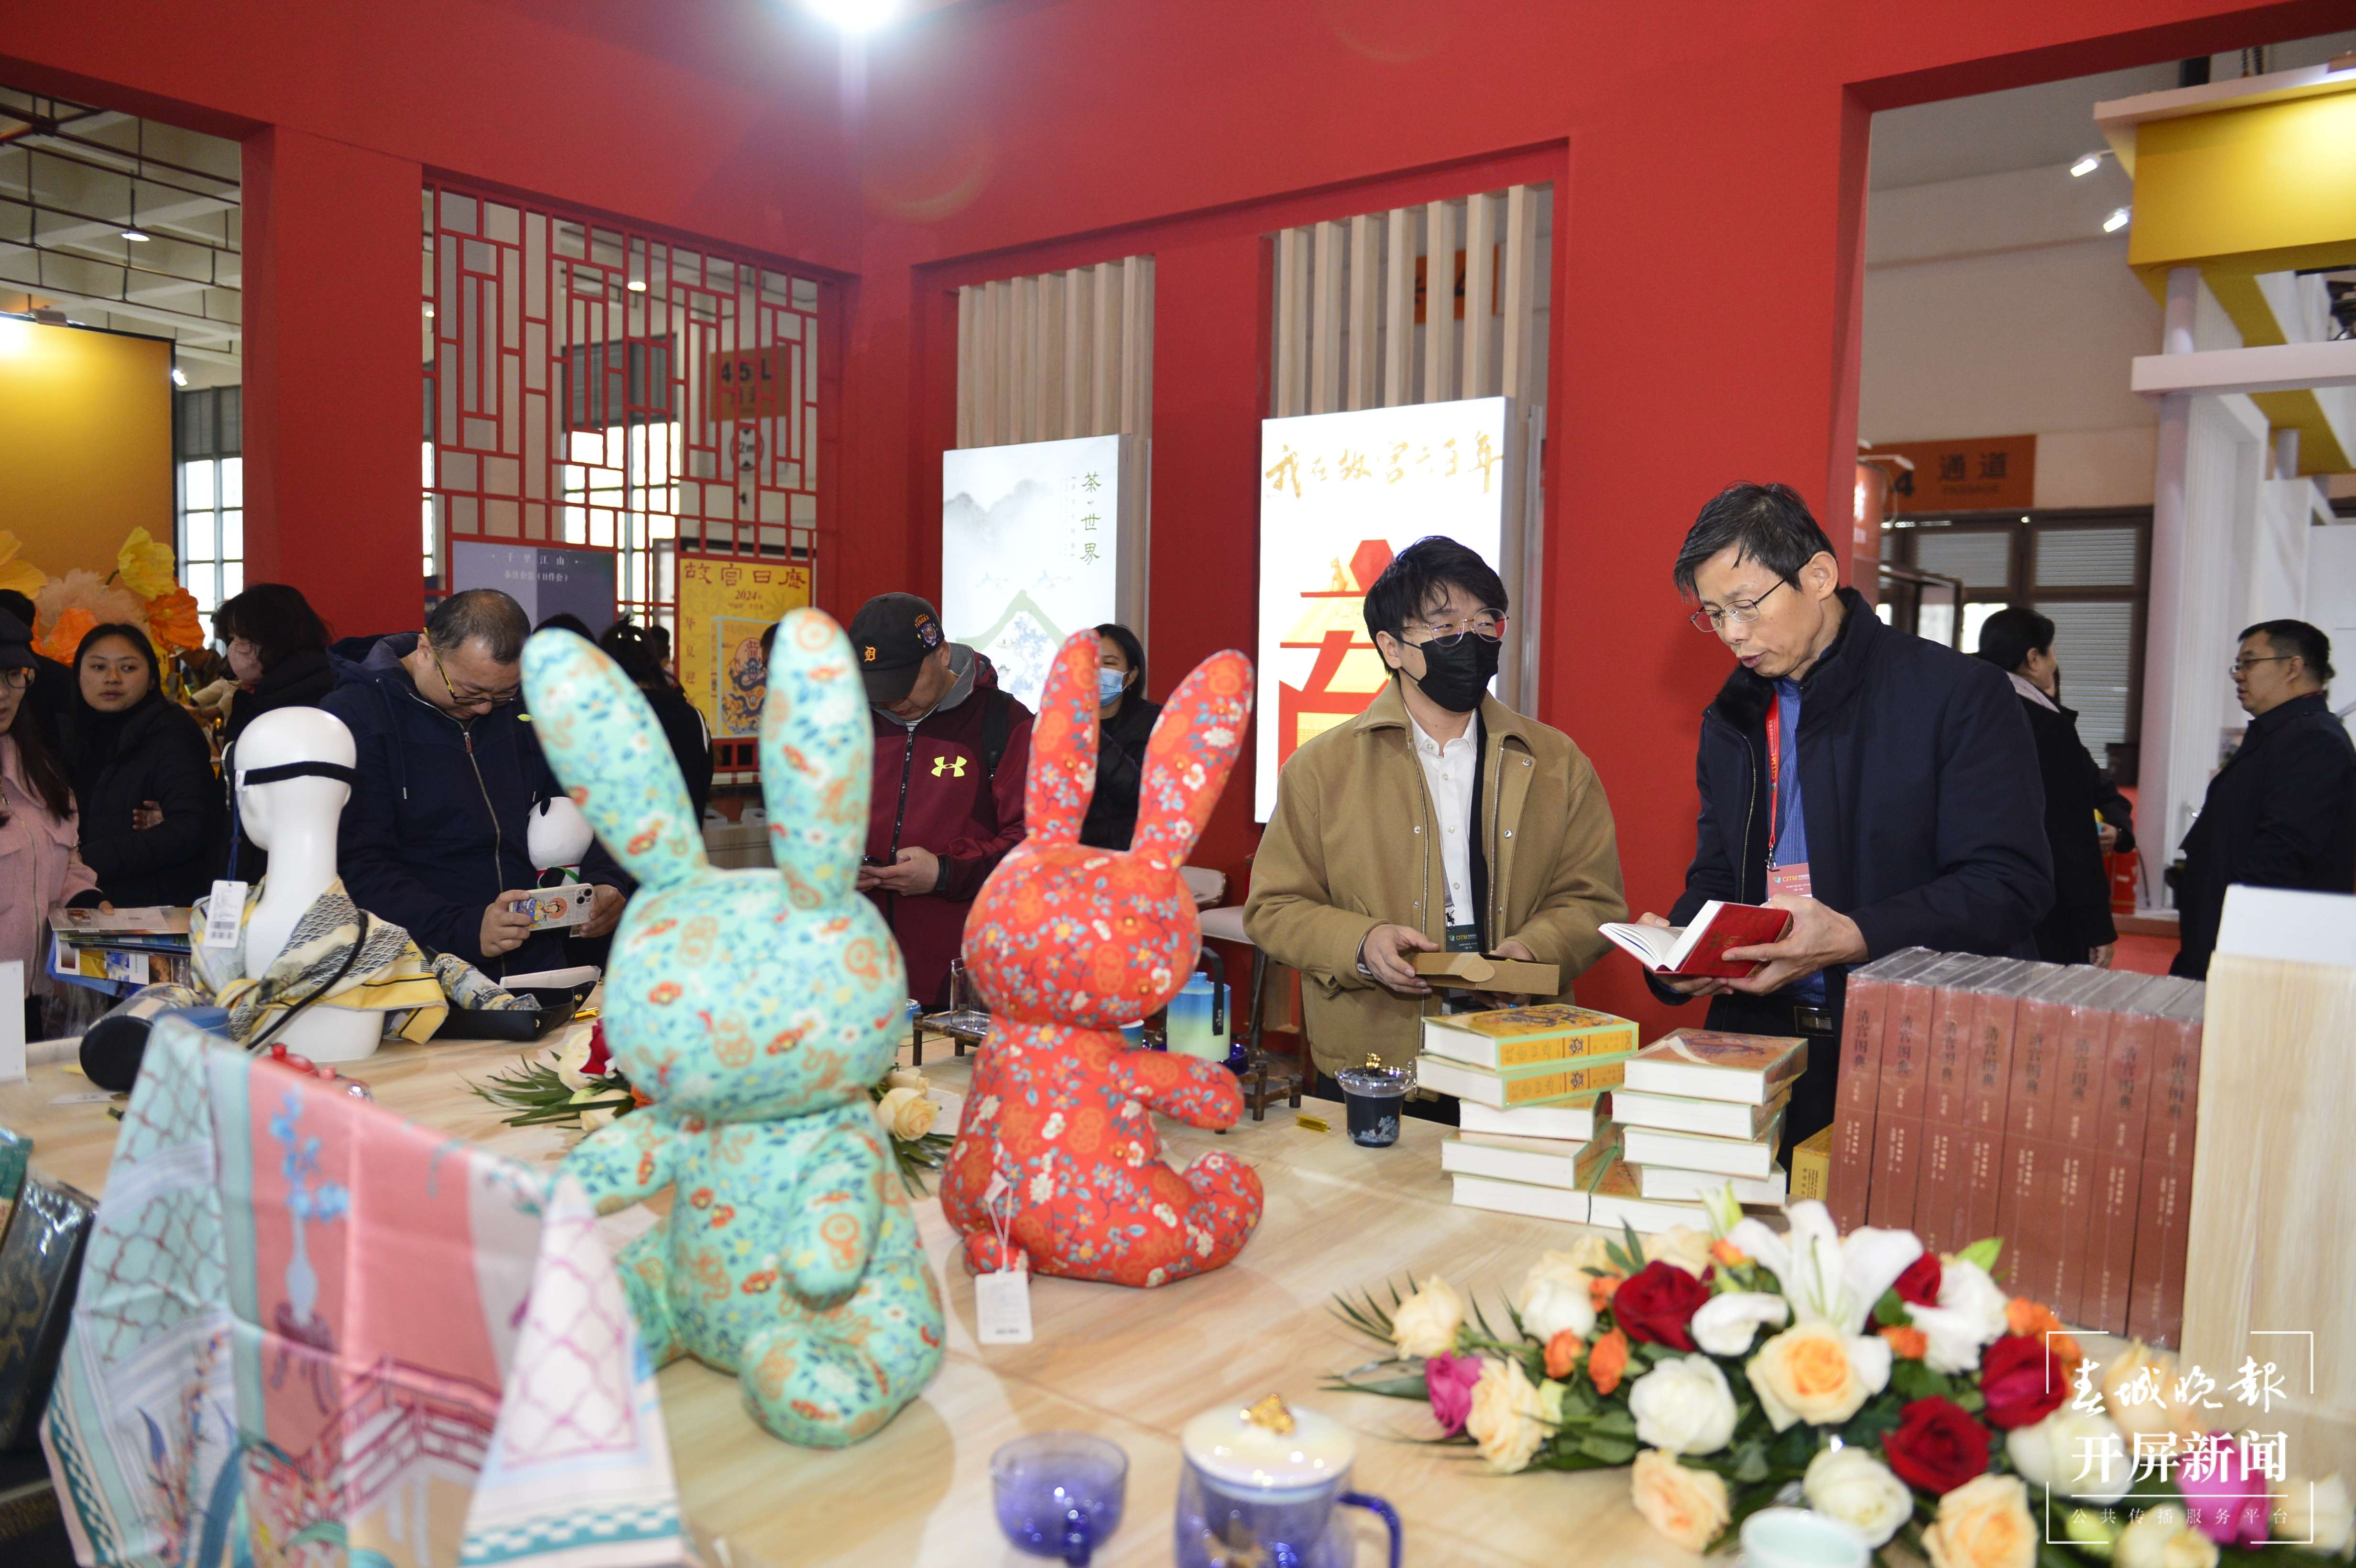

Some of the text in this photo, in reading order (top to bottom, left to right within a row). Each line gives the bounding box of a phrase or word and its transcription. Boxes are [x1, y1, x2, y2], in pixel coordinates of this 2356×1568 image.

[1939, 452, 2007, 481] 通道
[1080, 471, 1102, 566] 茶世界
